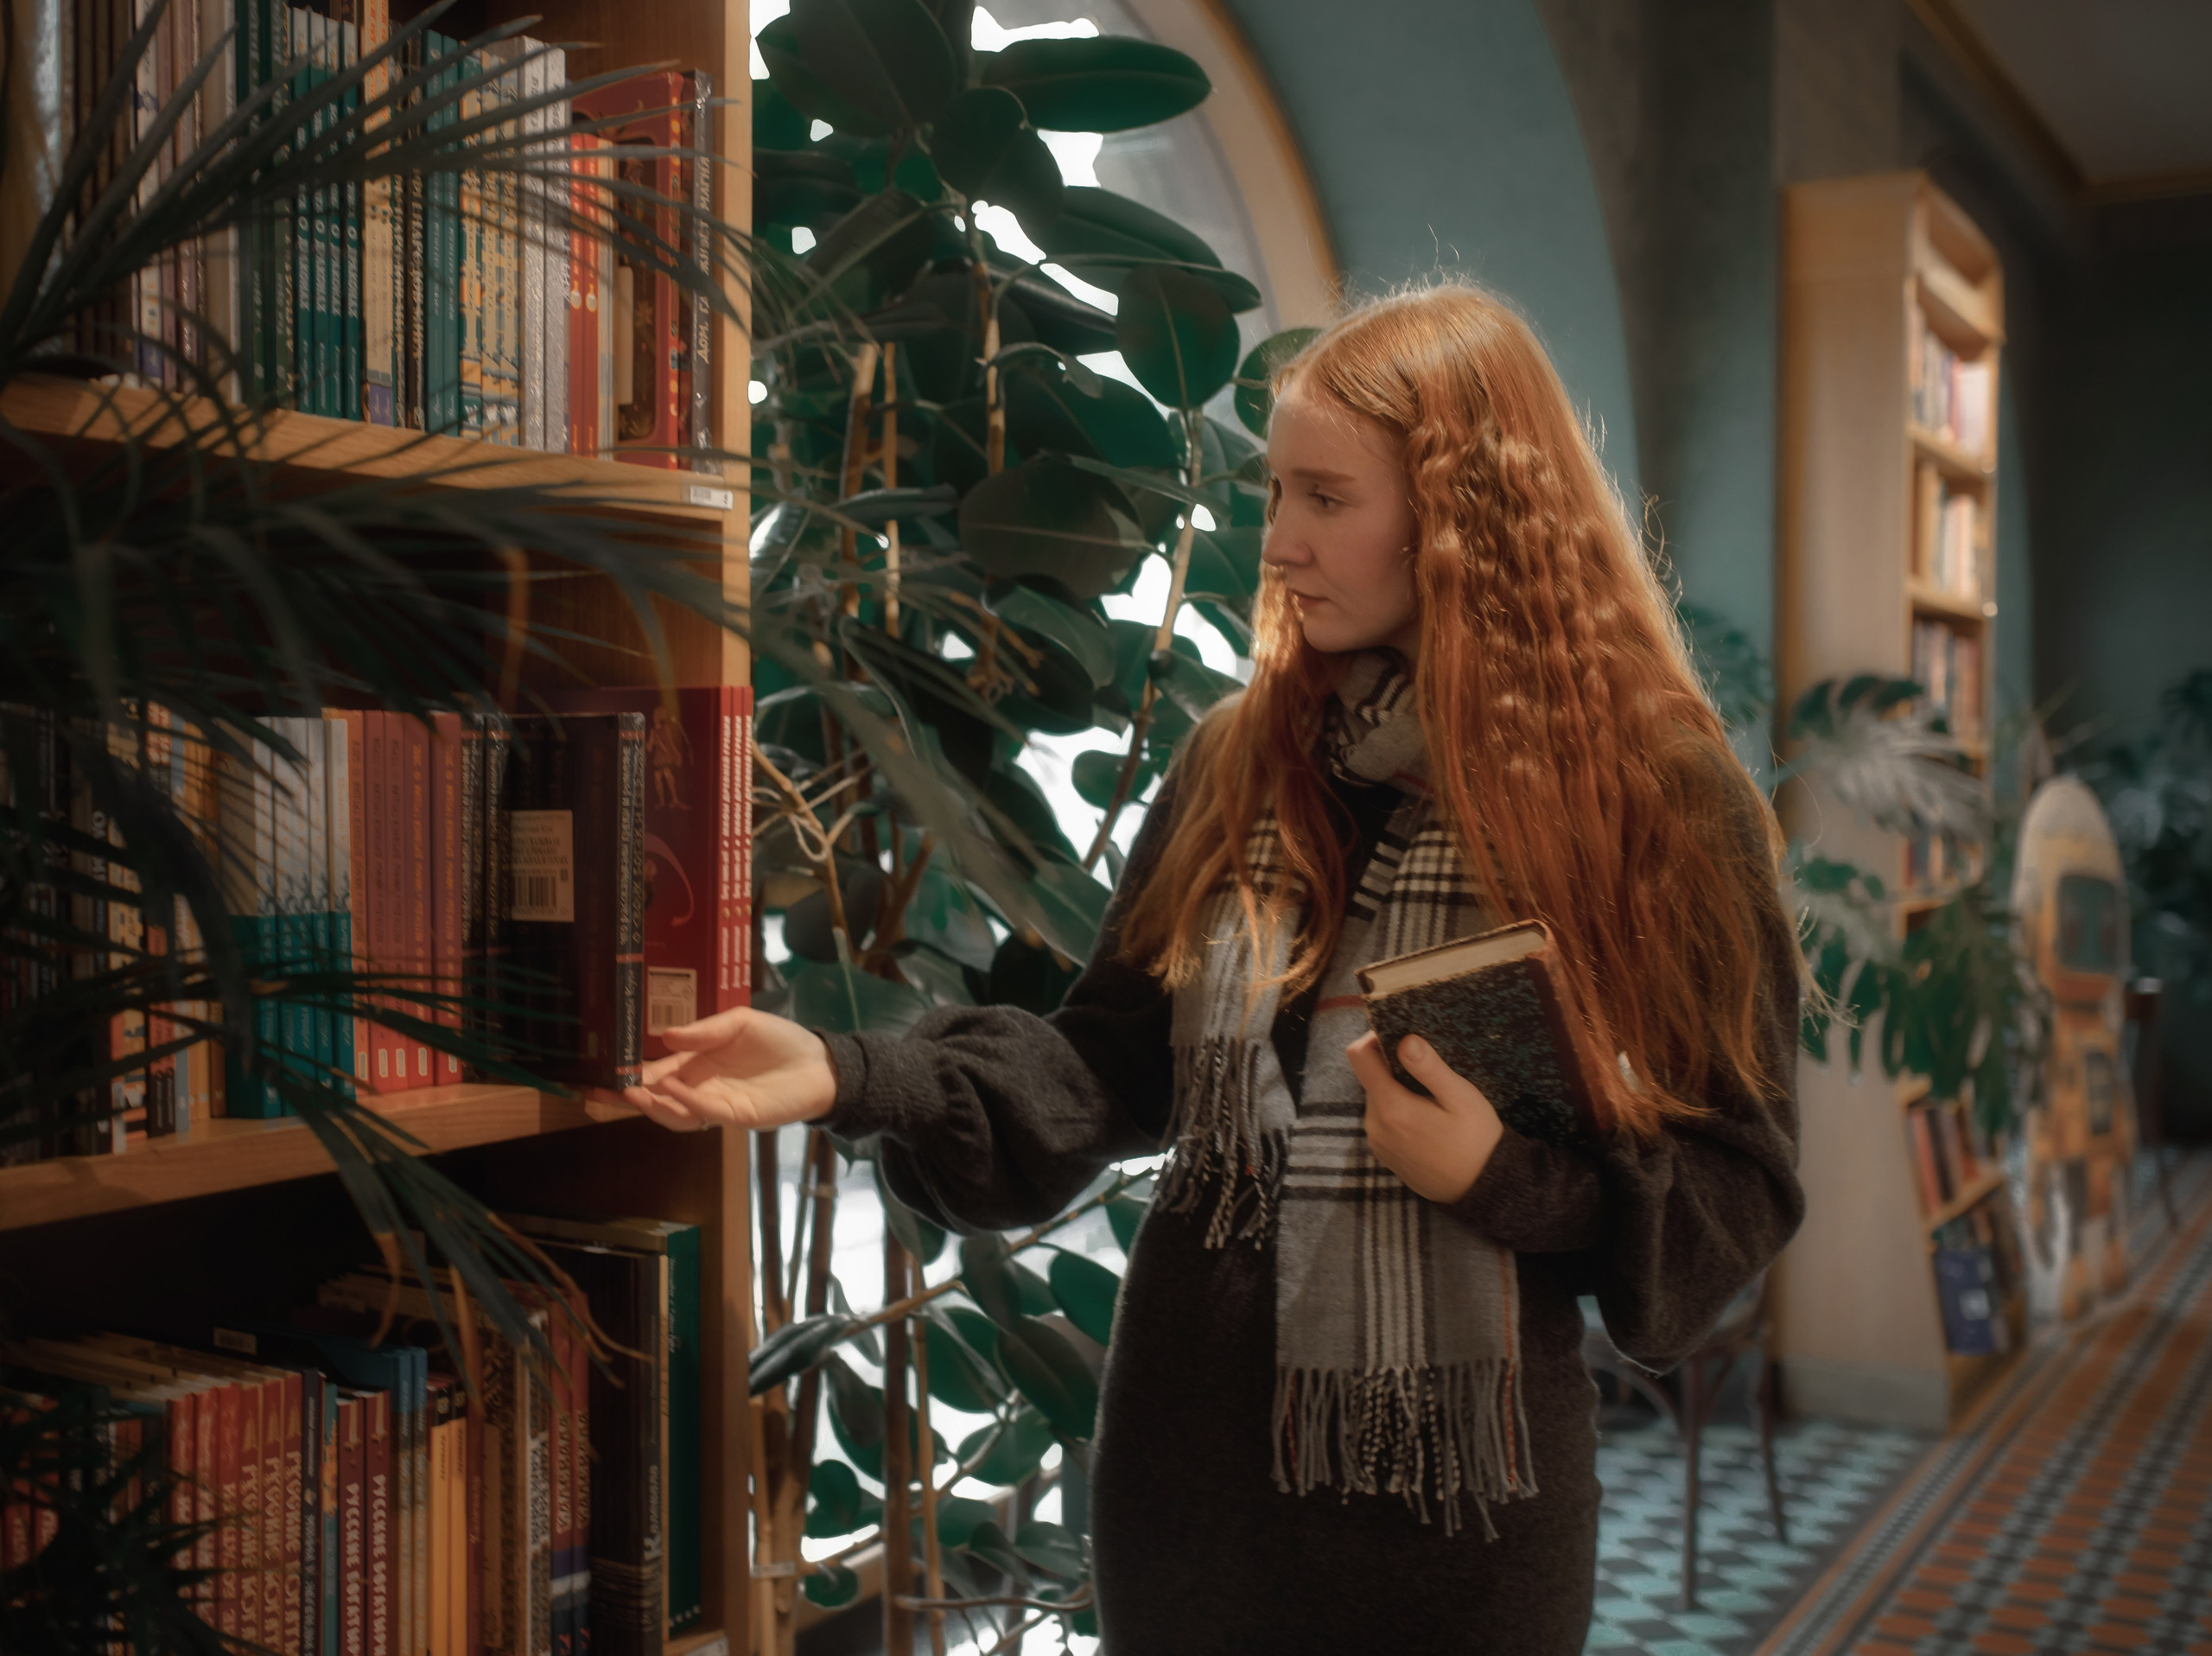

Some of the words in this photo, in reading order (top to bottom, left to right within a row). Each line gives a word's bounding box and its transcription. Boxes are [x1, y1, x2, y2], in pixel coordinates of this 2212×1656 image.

[697, 155, 710, 211] МАГИЯ
[297, 235, 310, 311] ДРАКОНАХ
[315, 239, 327, 314] ДРАКОНАХ
[330, 242, 341, 317] ДРАКОНАХ
[346, 245, 359, 319] ДРАКОНАХ
[263, 1457, 282, 1559] РУССКИЕ
[284, 1450, 302, 1552] РУССКИЕ
[346, 1482, 361, 1567] РУССКИЕ
[372, 1474, 387, 1557] РУССКИЕ
[346, 1570, 361, 1656] БОГАТЫР
